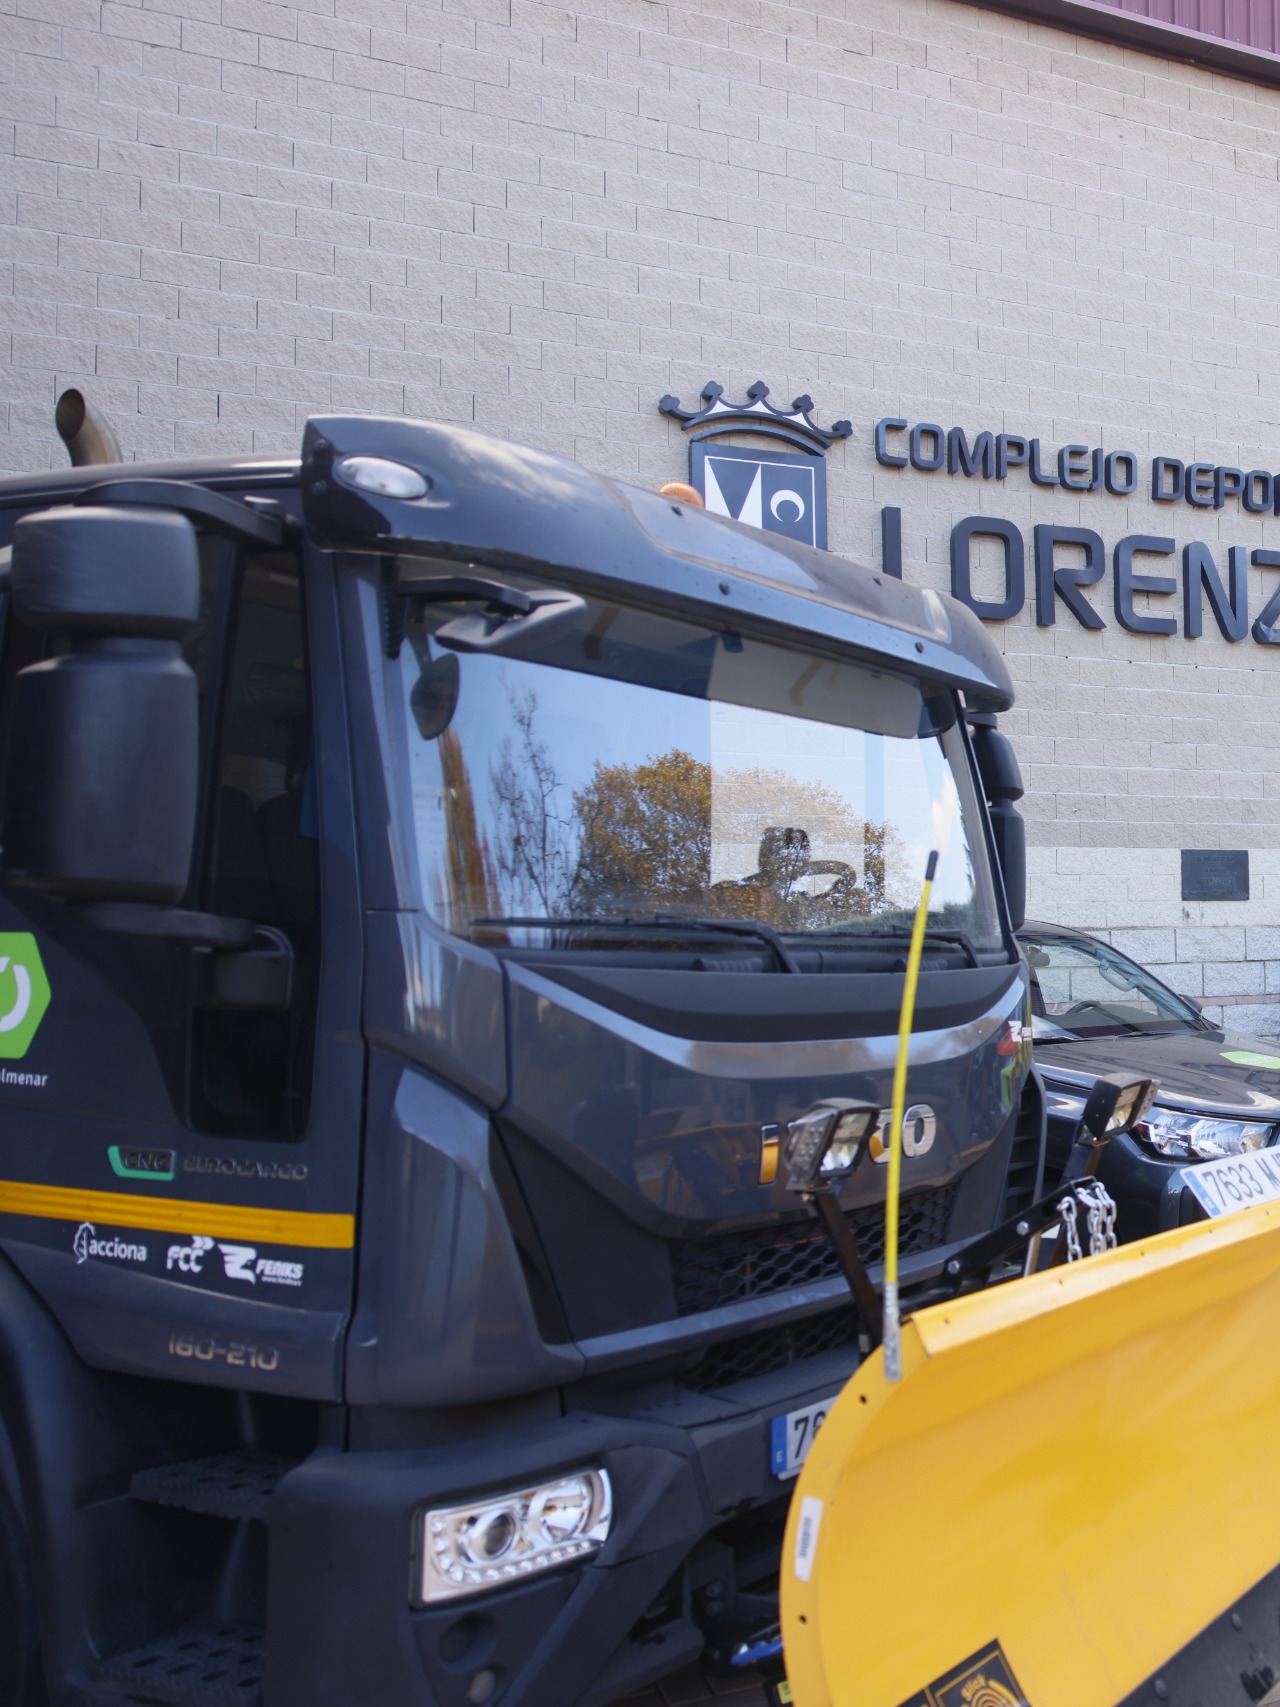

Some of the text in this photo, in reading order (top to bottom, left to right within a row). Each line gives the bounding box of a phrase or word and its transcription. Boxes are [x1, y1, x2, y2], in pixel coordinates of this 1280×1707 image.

[874, 416, 1138, 496] COMPLEJO
[0, 1068, 49, 1087] lmenar
[123, 1152, 169, 1172] CNG
[1201, 1162, 1265, 1207] 7633
[89, 1237, 148, 1262] acciona
[167, 1245, 204, 1273] FCC
